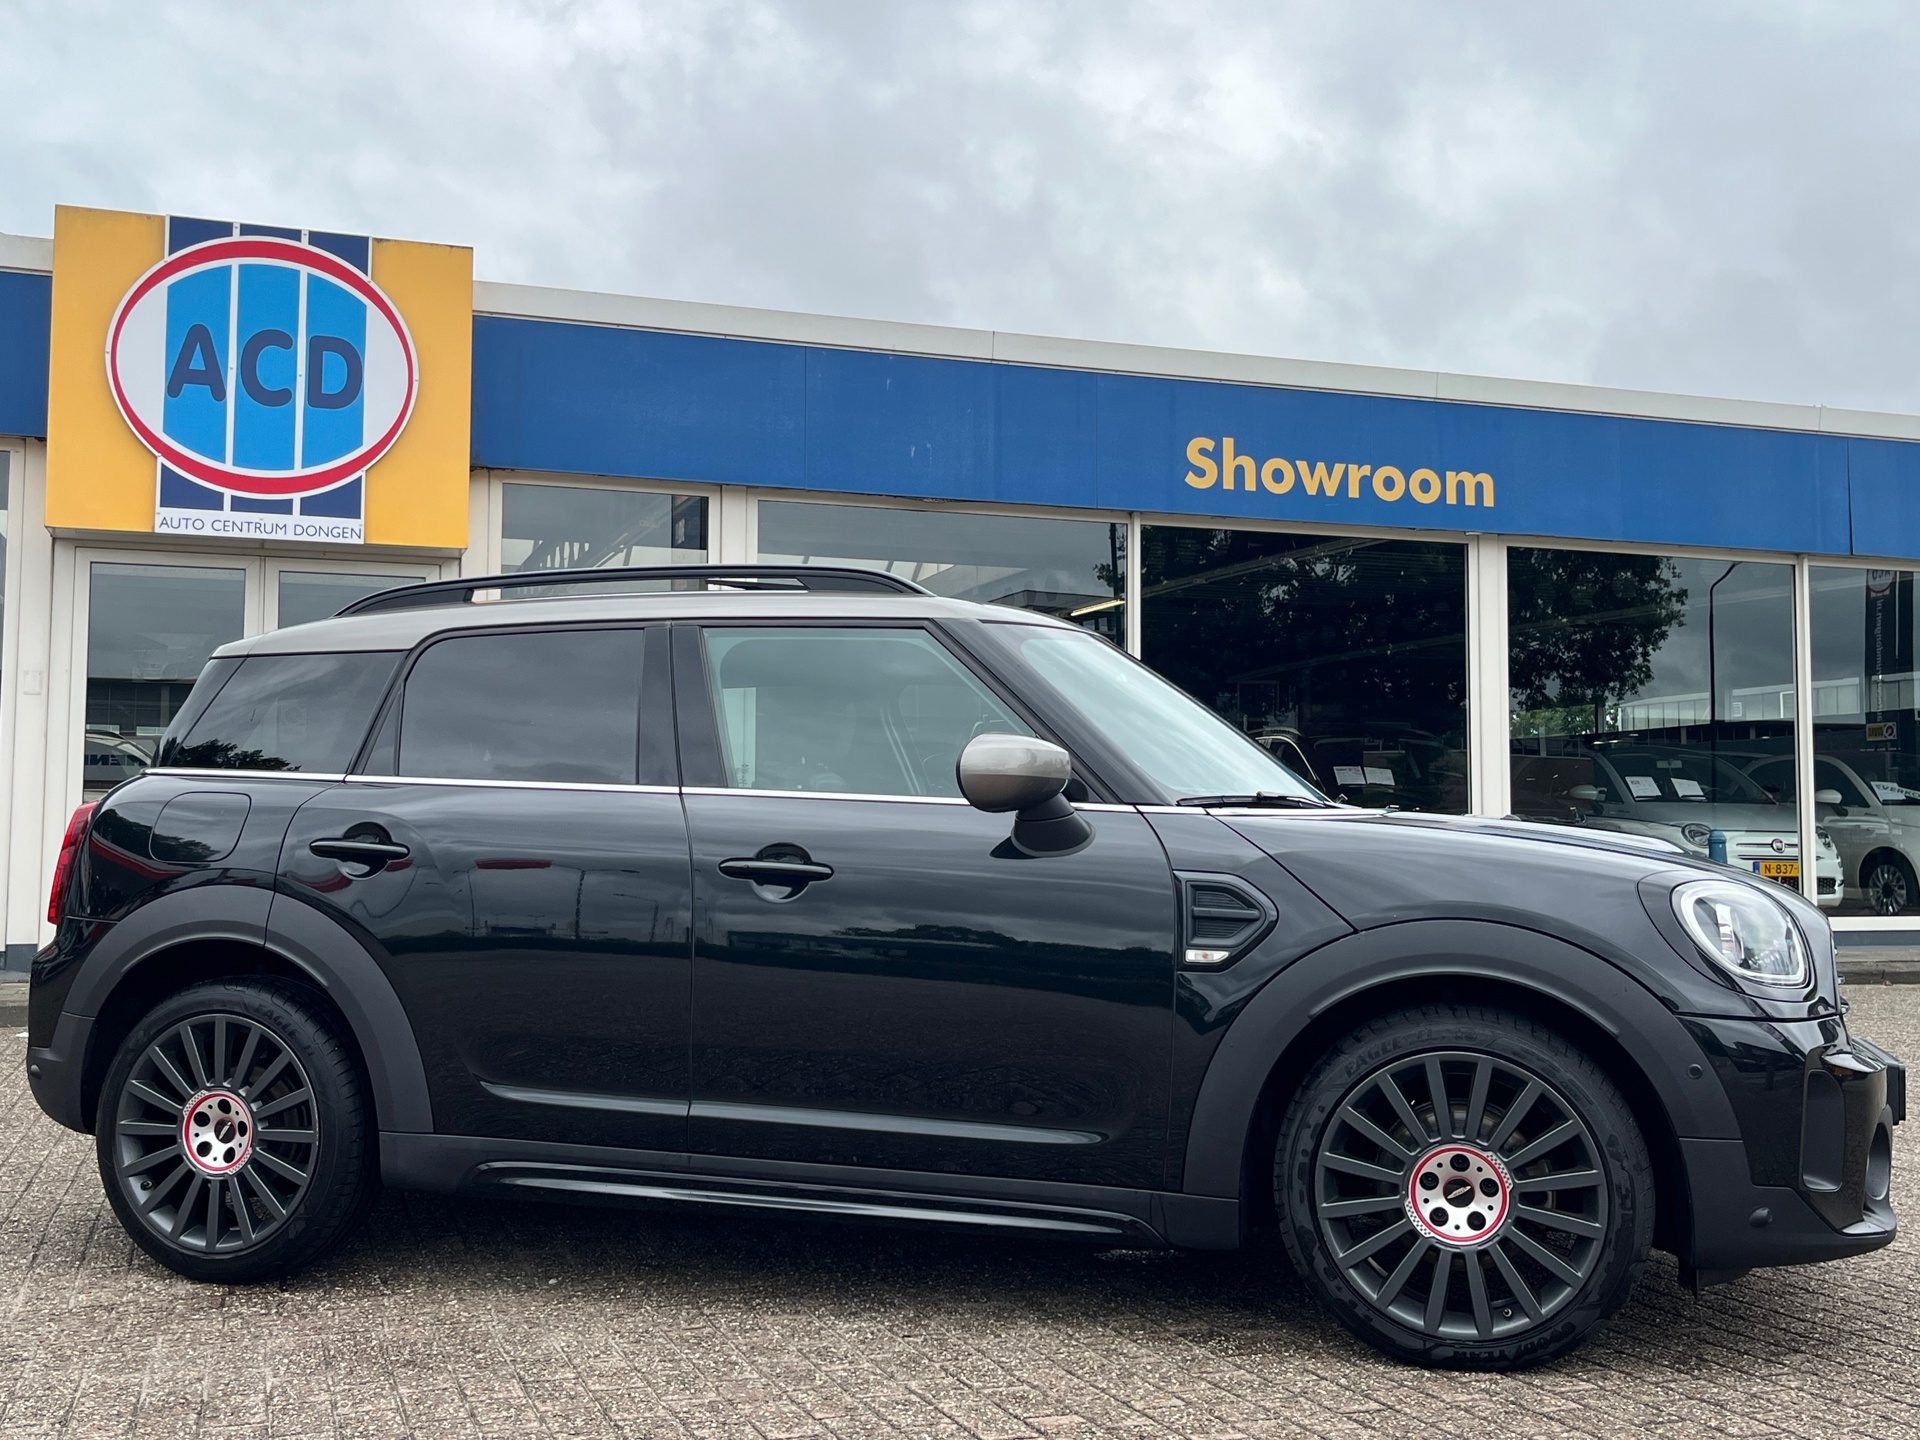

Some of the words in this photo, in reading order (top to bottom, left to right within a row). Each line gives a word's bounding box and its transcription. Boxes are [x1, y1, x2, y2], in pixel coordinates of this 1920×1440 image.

[167, 323, 364, 409] ACD
[1184, 437, 1495, 507] Showroom
[159, 516, 205, 531] AUTO
[211, 519, 287, 536] CENTRUM
[293, 524, 362, 539] DONGEN
[1343, 1036, 1403, 1078] EAGLE
